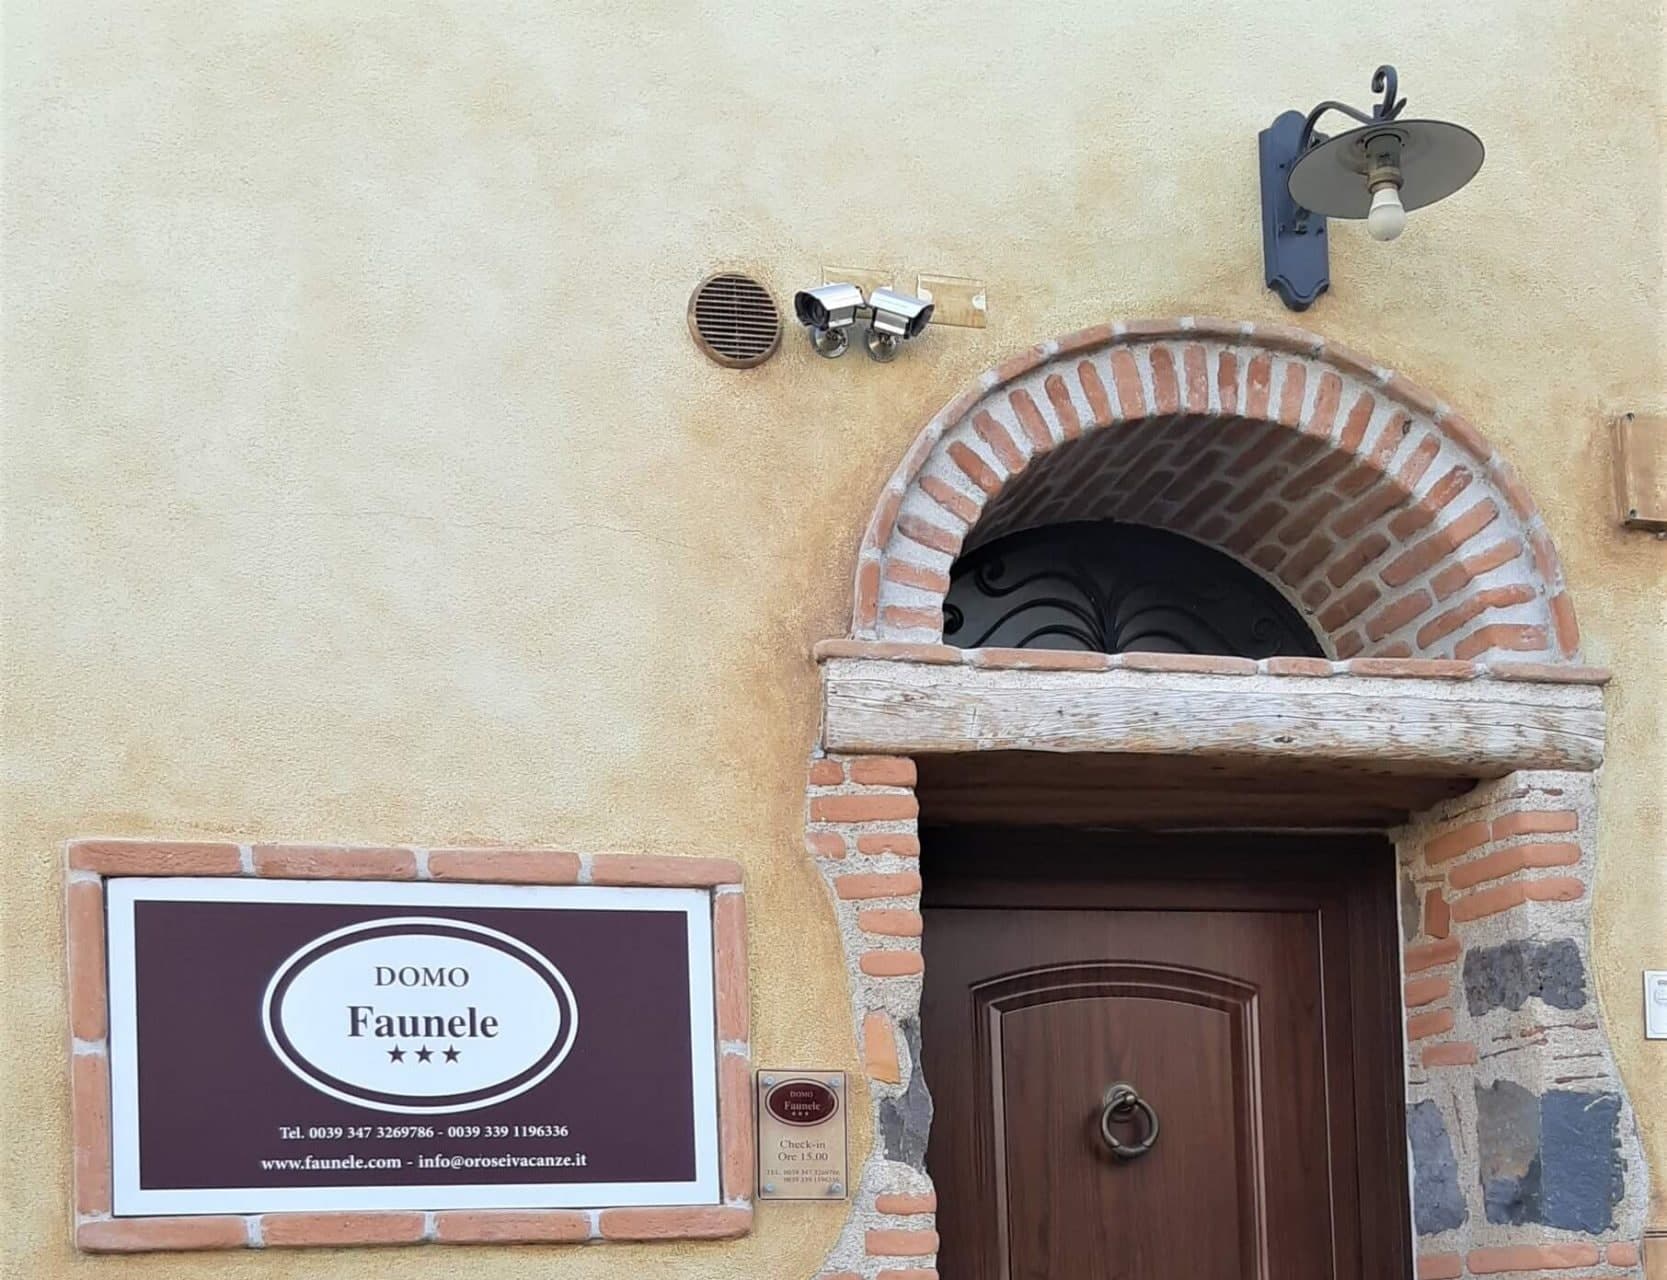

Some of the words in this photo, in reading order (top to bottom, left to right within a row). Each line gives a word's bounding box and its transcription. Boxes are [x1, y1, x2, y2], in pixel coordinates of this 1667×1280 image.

[374, 966, 470, 988] DOMO
[347, 1005, 499, 1038] Faunele
[784, 1100, 821, 1111] Faunele
[279, 1126, 305, 1139] Tel.
[309, 1126, 343, 1139] 0039
[347, 1126, 372, 1139] 347
[377, 1125, 434, 1139] 3269786
[447, 1125, 481, 1138] 0039
[484, 1125, 509, 1138] 339
[513, 1125, 569, 1138] 1196336
[780, 1140, 826, 1149] Check-in
[261, 1154, 402, 1170] www.faunele.com
[418, 1153, 588, 1170] info@oroseivacanze.it
[801, 1152, 829, 1161] 15.00
